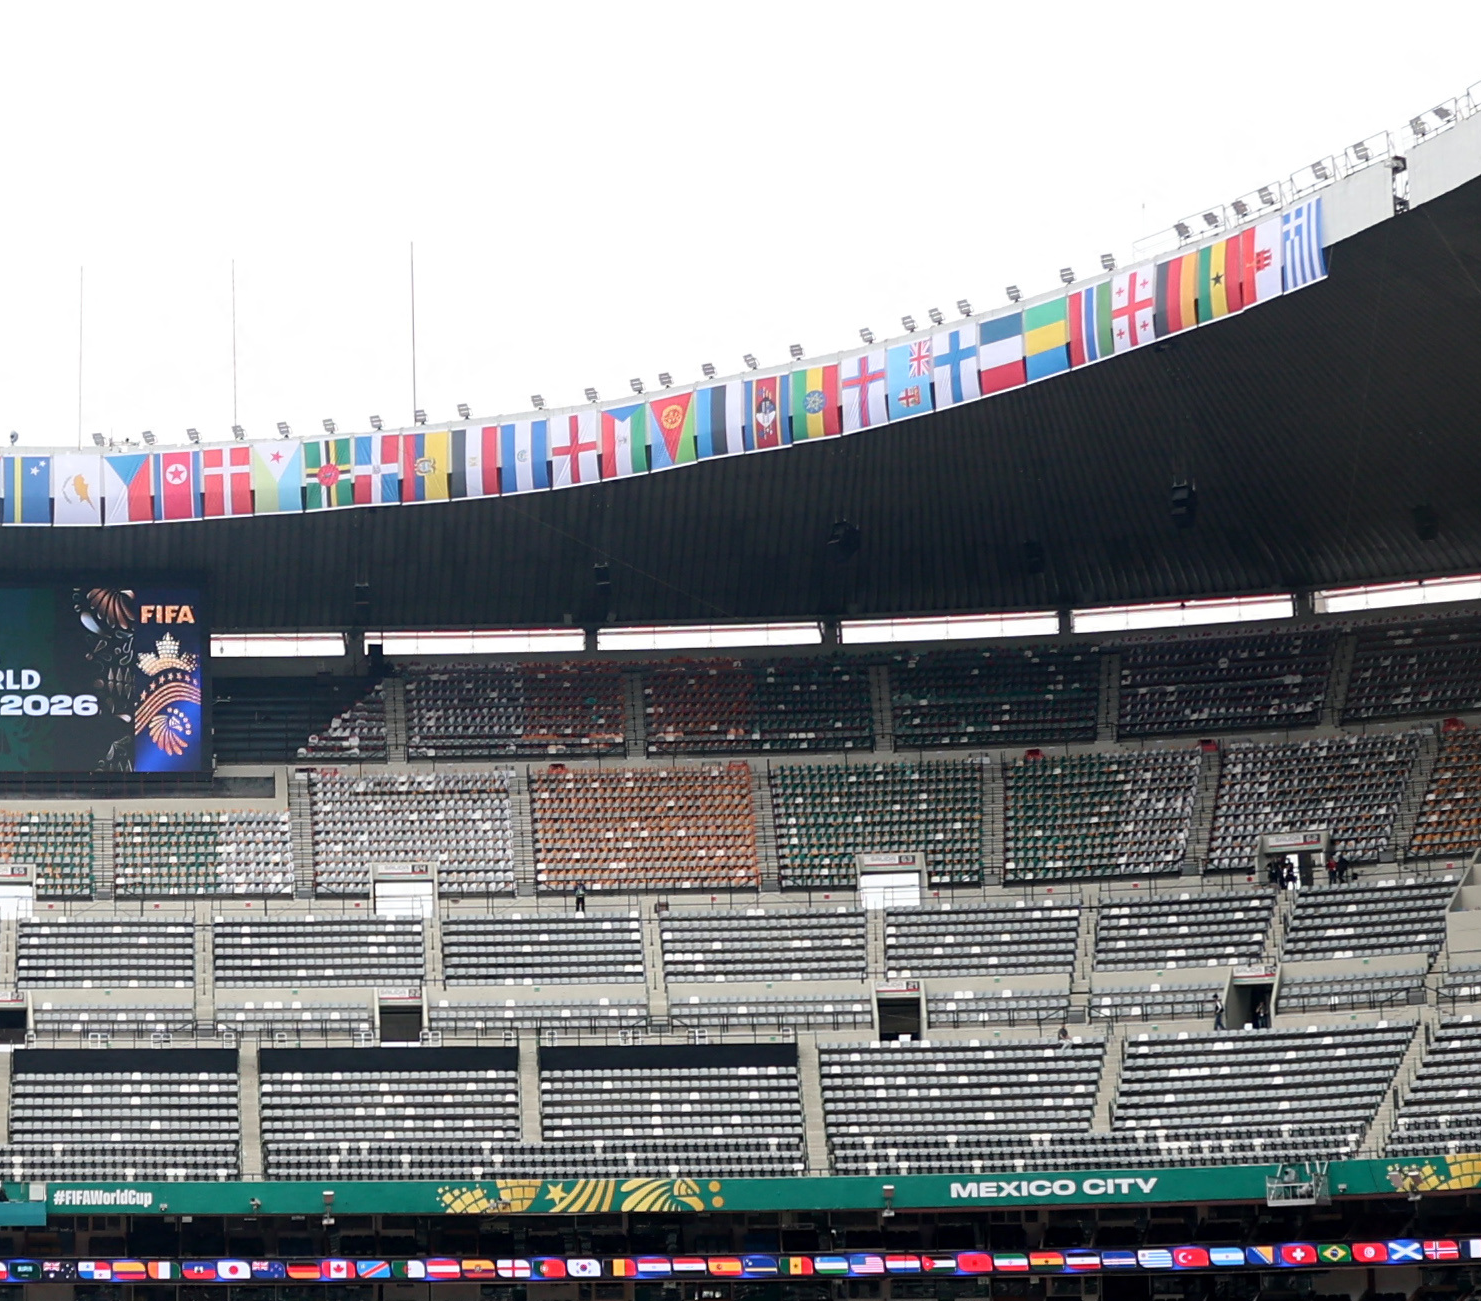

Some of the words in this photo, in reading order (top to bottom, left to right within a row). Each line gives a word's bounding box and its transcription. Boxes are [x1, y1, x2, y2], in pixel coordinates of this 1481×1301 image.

[140, 605, 195, 624] FIFA
[0, 694, 99, 716] 2026
[950, 1180, 1076, 1198] MEXICO
[1083, 1178, 1158, 1195] CITY
[53, 1189, 153, 1207] #FIFAWorldCup
